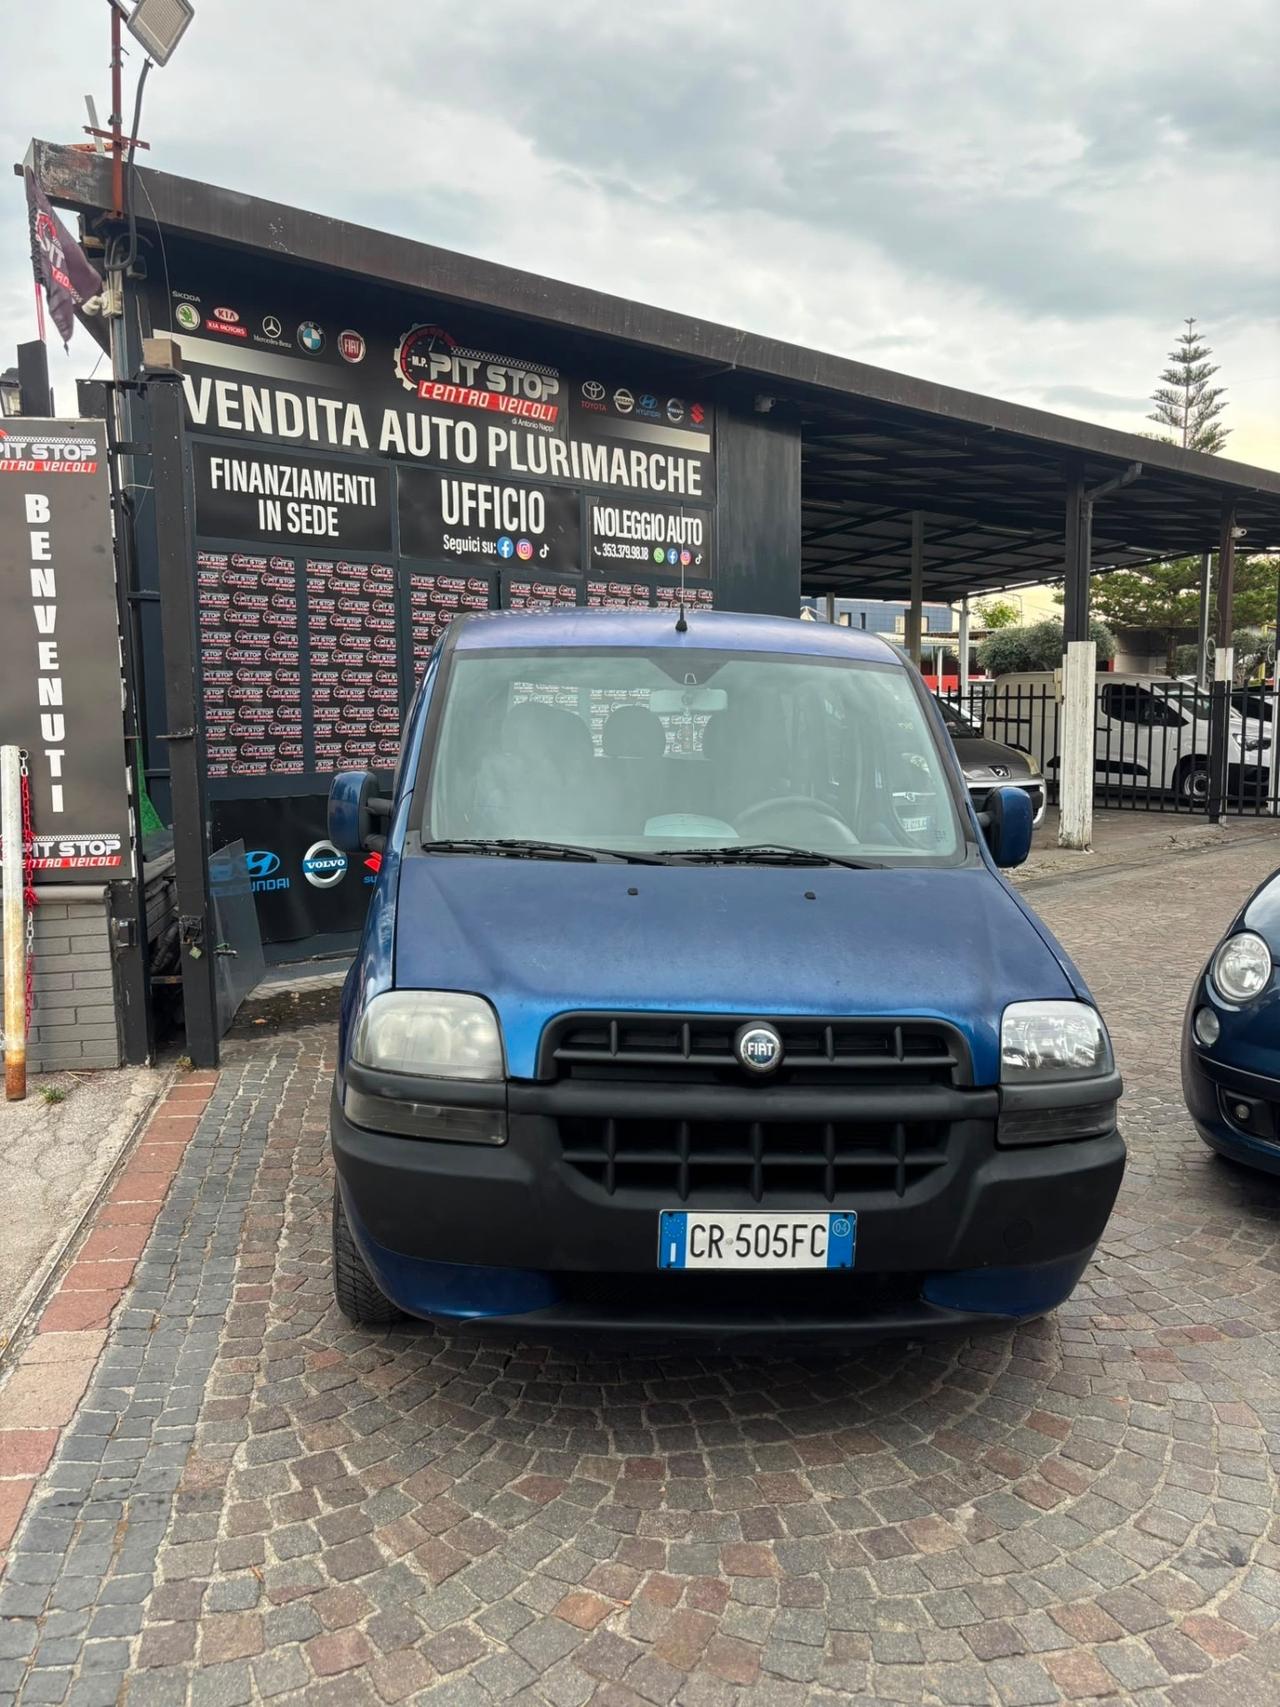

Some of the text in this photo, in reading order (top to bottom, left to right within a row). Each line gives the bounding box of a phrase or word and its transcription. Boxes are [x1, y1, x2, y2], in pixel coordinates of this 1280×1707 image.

[217, 309, 236, 320] KIA
[220, 324, 245, 334] MOTORS
[344, 339, 360, 354] FIAT
[428, 352, 560, 402] PIT STOP
[582, 401, 607, 412] TOYOTA
[518, 418, 538, 429] Antonio
[183, 374, 703, 496] VENDITA AUTO PLURIMARCHE
[0, 442, 96, 462] IT STOP
[210, 457, 376, 506] FINANZIAMENTI
[440, 478, 546, 534] UFFICIO
[258, 499, 340, 537] IN SEDE
[593, 506, 702, 546] NOLEGGIO AUTO
[443, 534, 496, 555] Seguici su:
[24, 494, 66, 812] BENVENUTI
[22, 840, 120, 858] IT STOP
[306, 859, 345, 869] VOLVO
[748, 1042, 774, 1056] FIAT
[690, 1224, 827, 1258] CR 505FC
[670, 1242, 676, 1262] I
